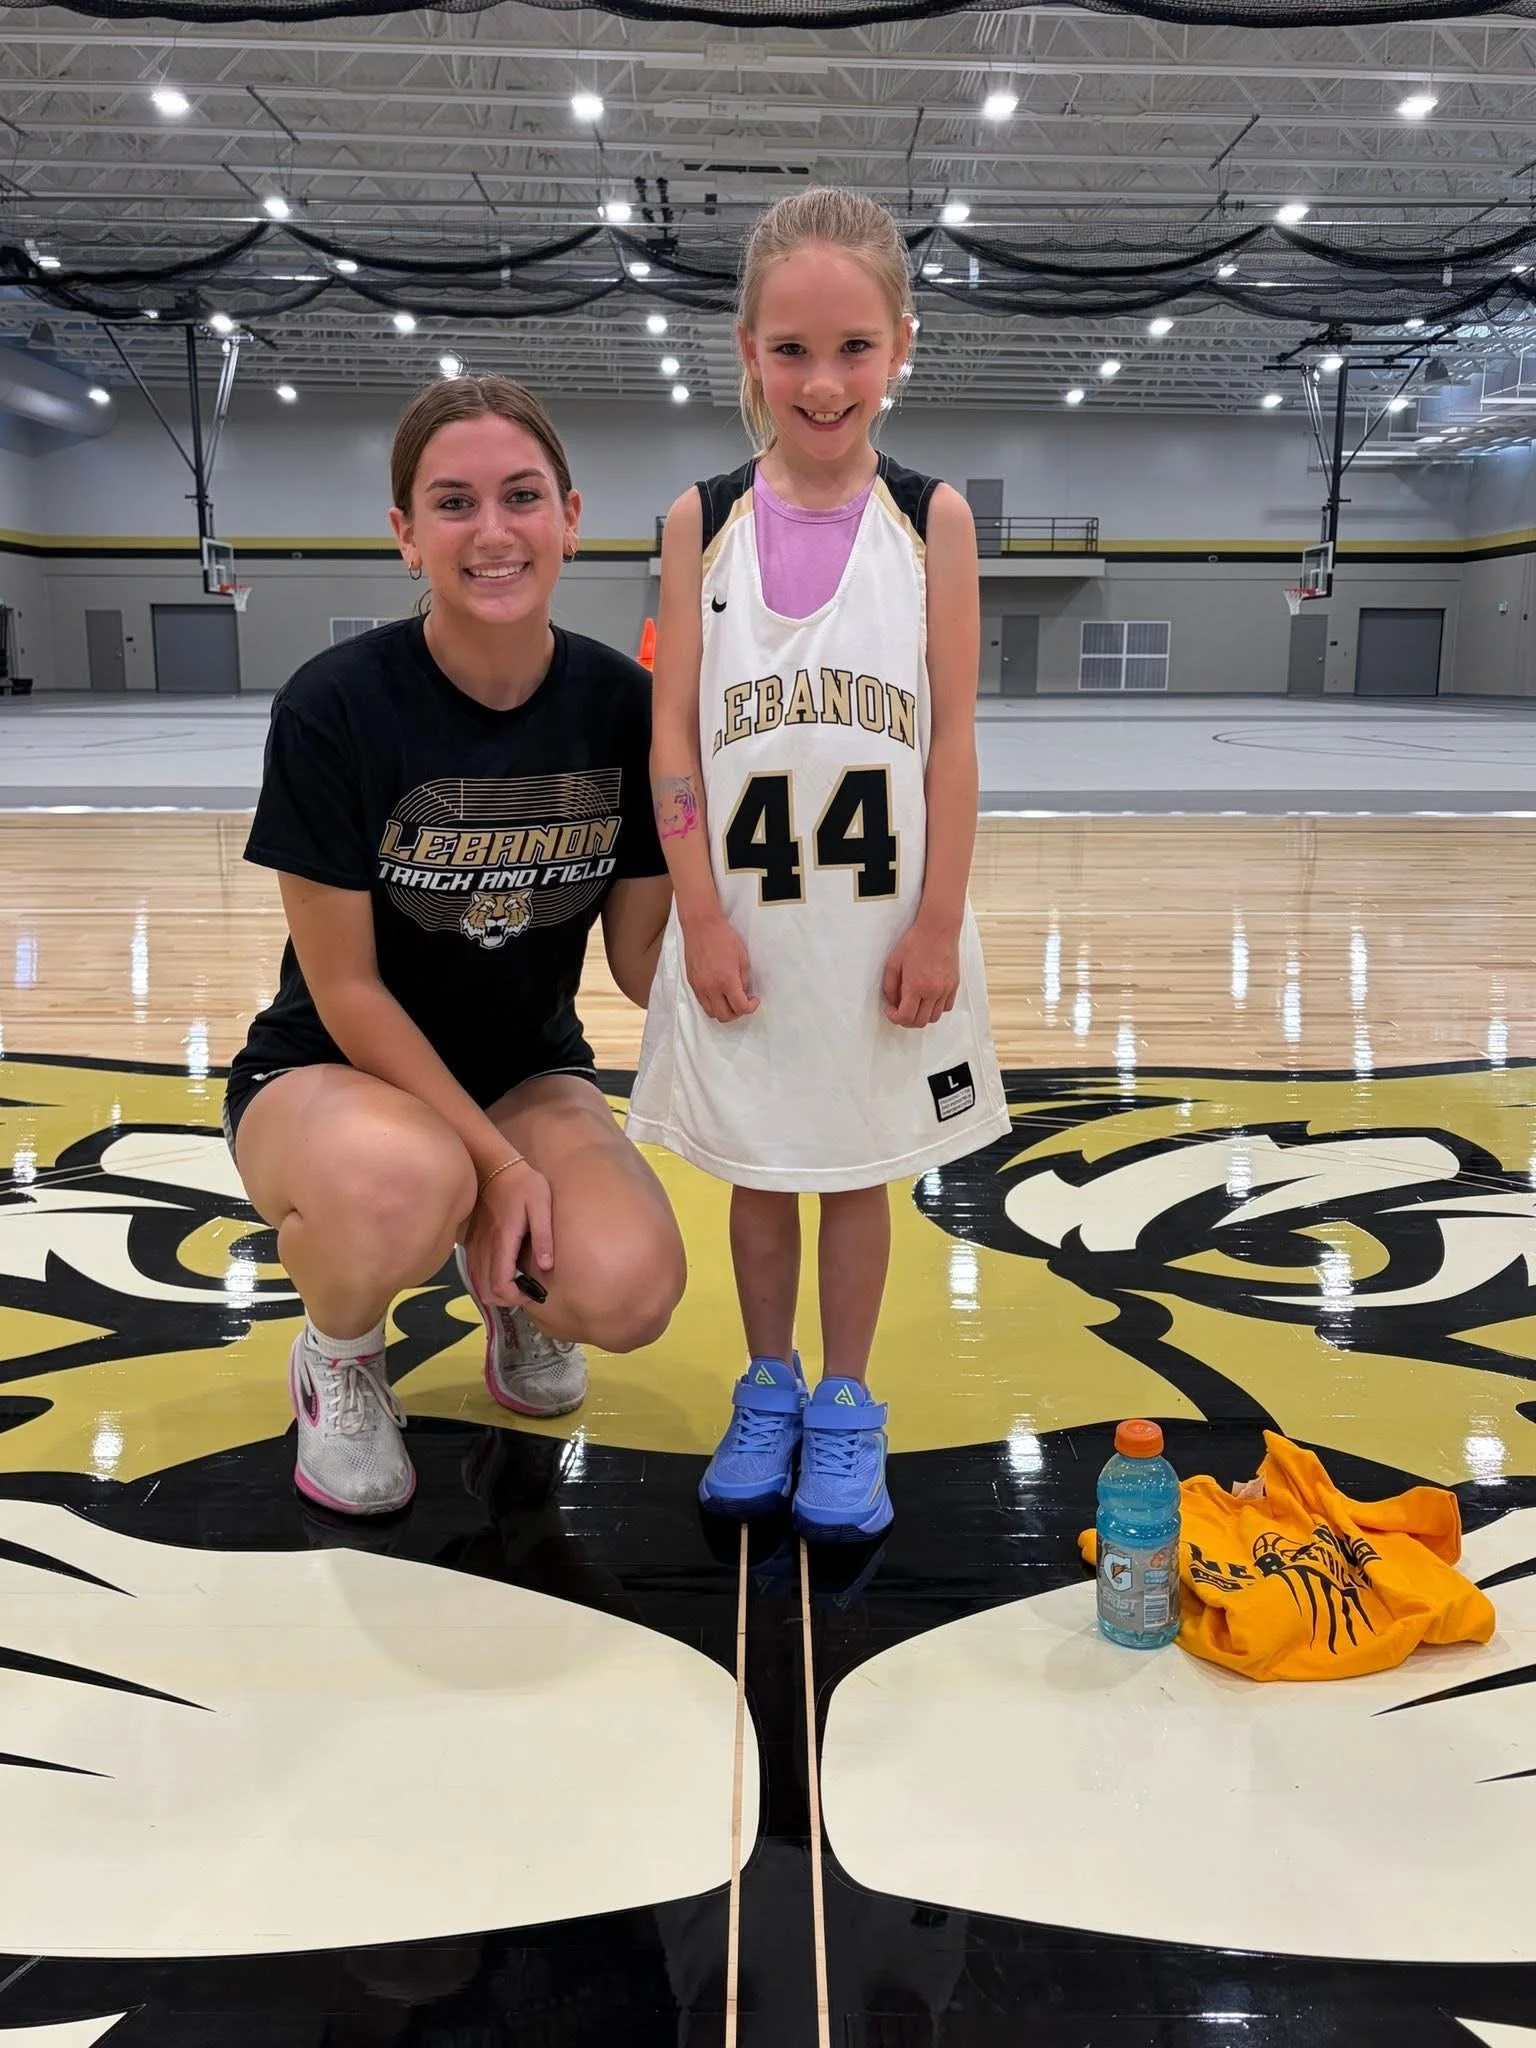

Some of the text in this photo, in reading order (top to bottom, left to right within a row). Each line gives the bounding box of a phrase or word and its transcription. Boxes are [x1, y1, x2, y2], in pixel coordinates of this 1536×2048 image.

[378, 816, 622, 869] LEBANON
[722, 763, 901, 907] 44
[378, 858, 617, 891] TRACK AND FIELD
[947, 1075, 960, 1089] L
[1103, 1553, 1133, 1592] G
